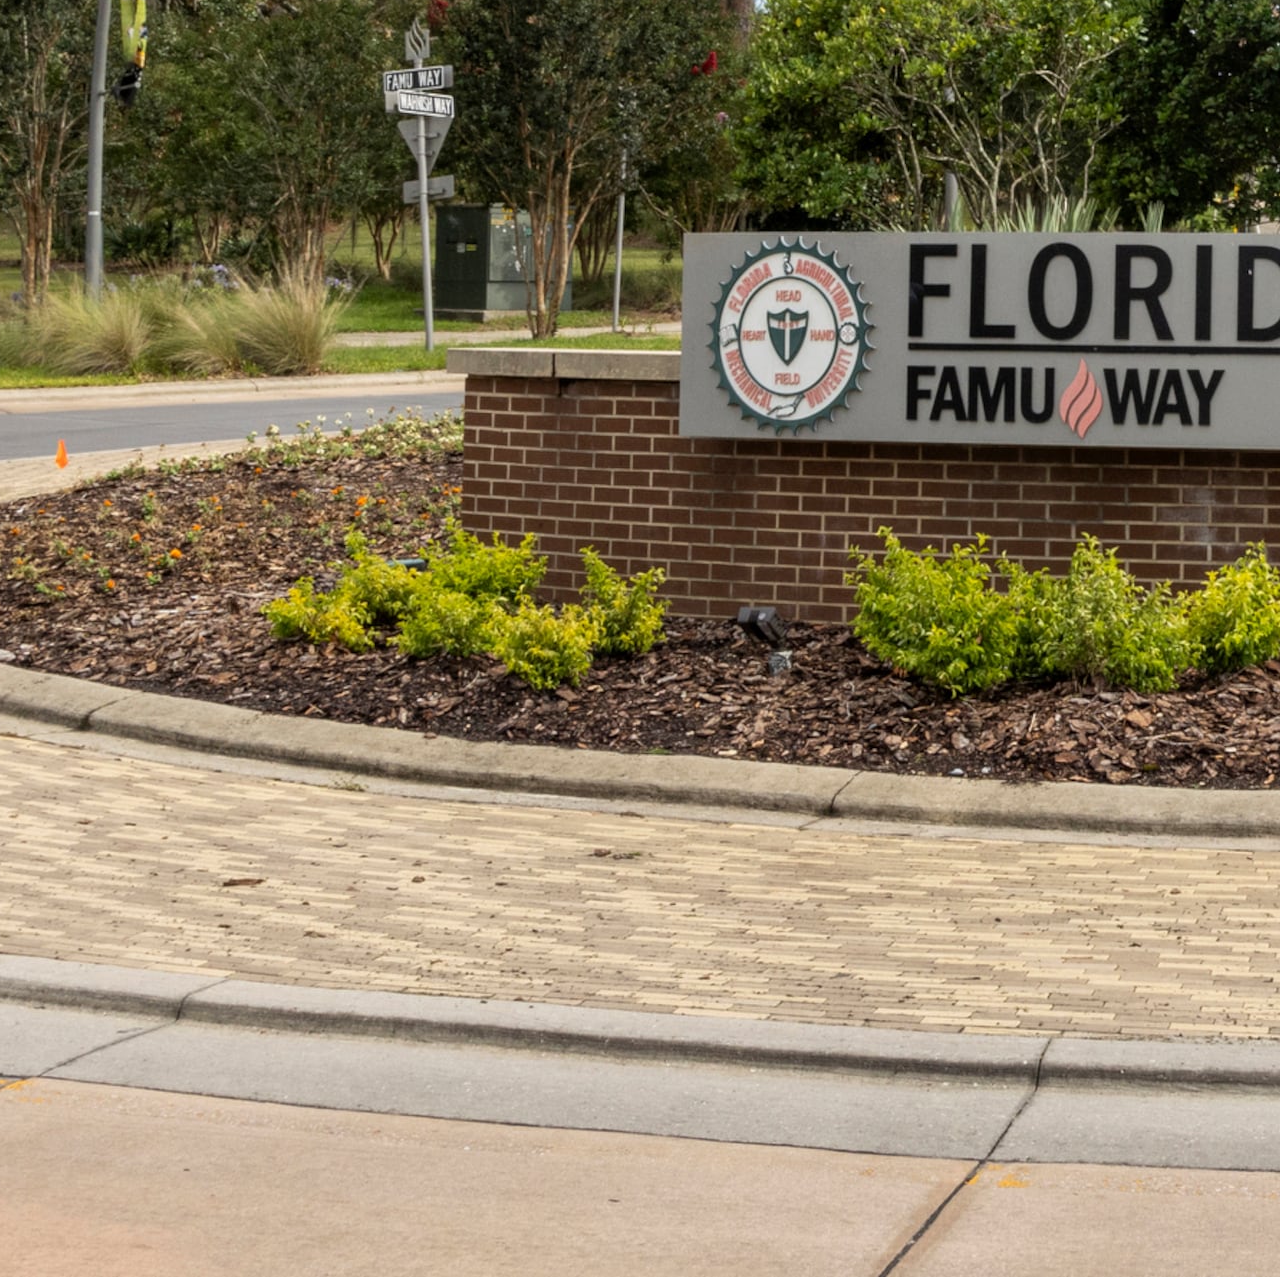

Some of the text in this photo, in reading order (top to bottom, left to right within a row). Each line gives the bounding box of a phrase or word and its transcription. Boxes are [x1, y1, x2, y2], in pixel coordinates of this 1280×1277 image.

[386, 69, 441, 91] FAMU WAY
[434, 98, 452, 114] WAY
[728, 259, 854, 321] FLORIDA AGRICULTURAL
[776, 290, 801, 301] HEAD
[742, 330, 836, 341] HEART HAND
[725, 348, 853, 411] MECHANICAL UNIVERSITY
[775, 373, 801, 385] FIELD
[906, 365, 1226, 426] FAMU WAY
